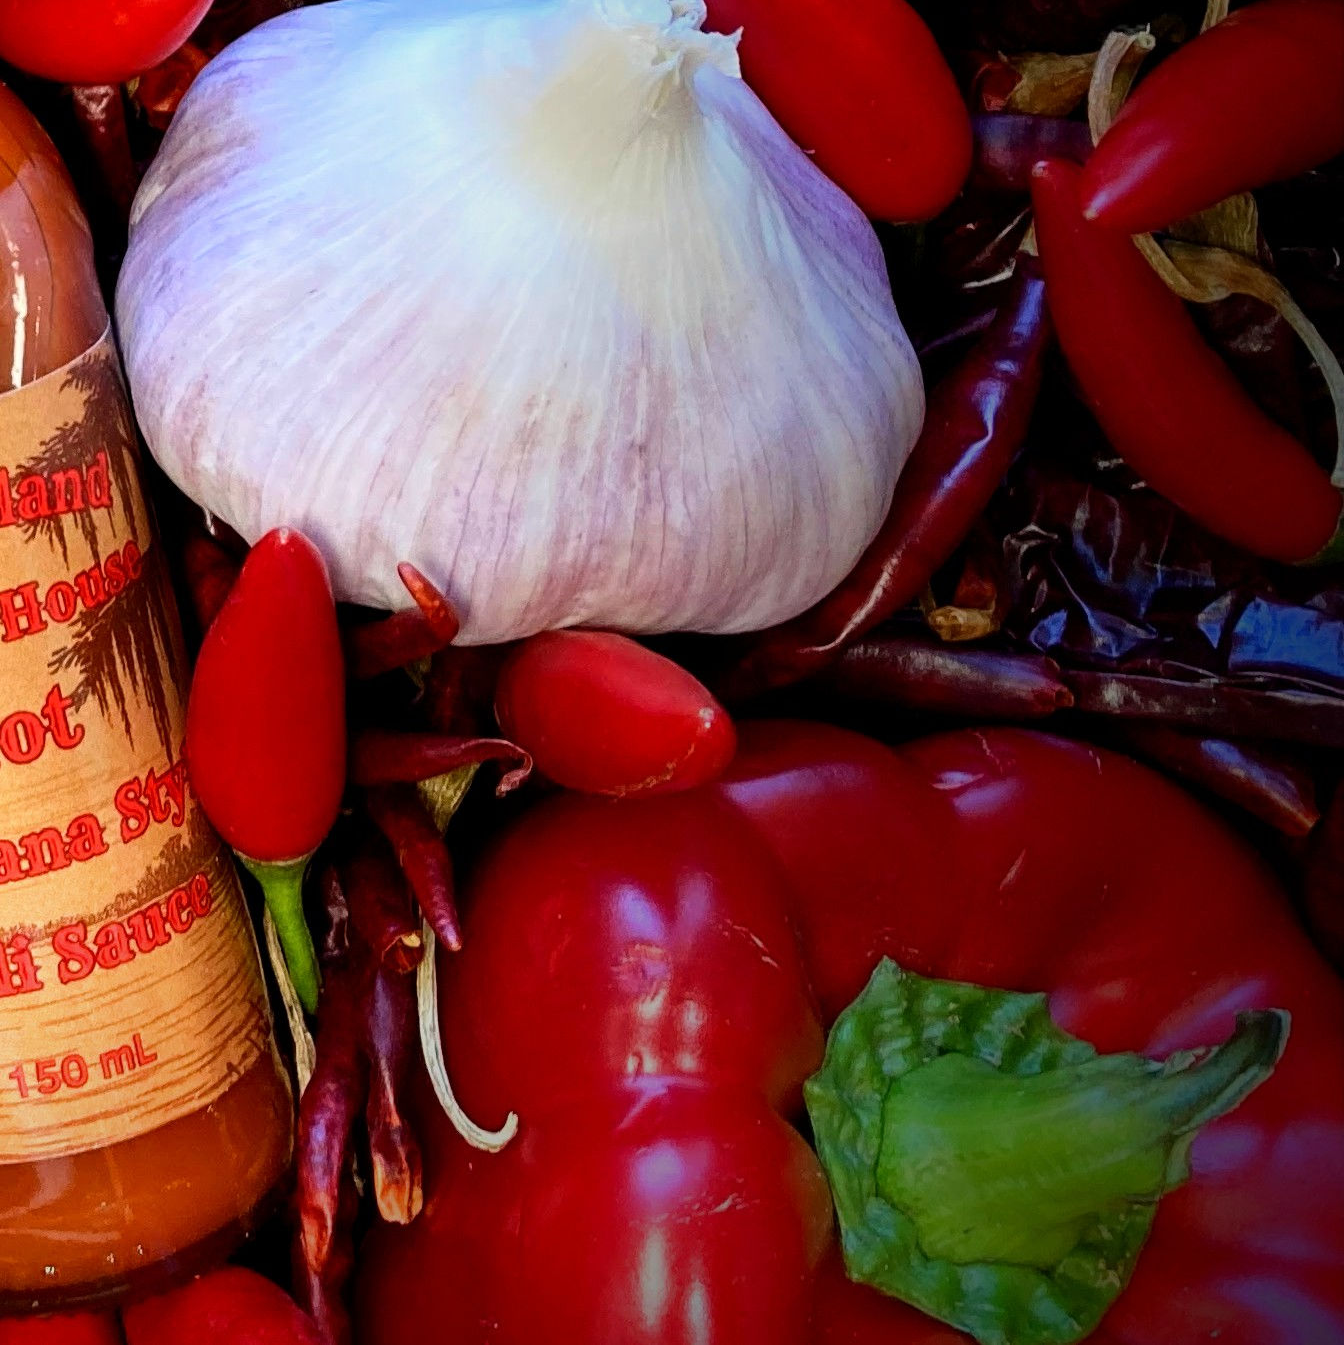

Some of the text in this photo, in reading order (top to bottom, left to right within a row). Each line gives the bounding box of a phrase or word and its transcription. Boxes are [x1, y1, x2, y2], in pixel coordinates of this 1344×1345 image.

[114, 756, 192, 842] Sty
[56, 871, 212, 980] Sauce
[8, 1032, 158, 1099] 150 mL
